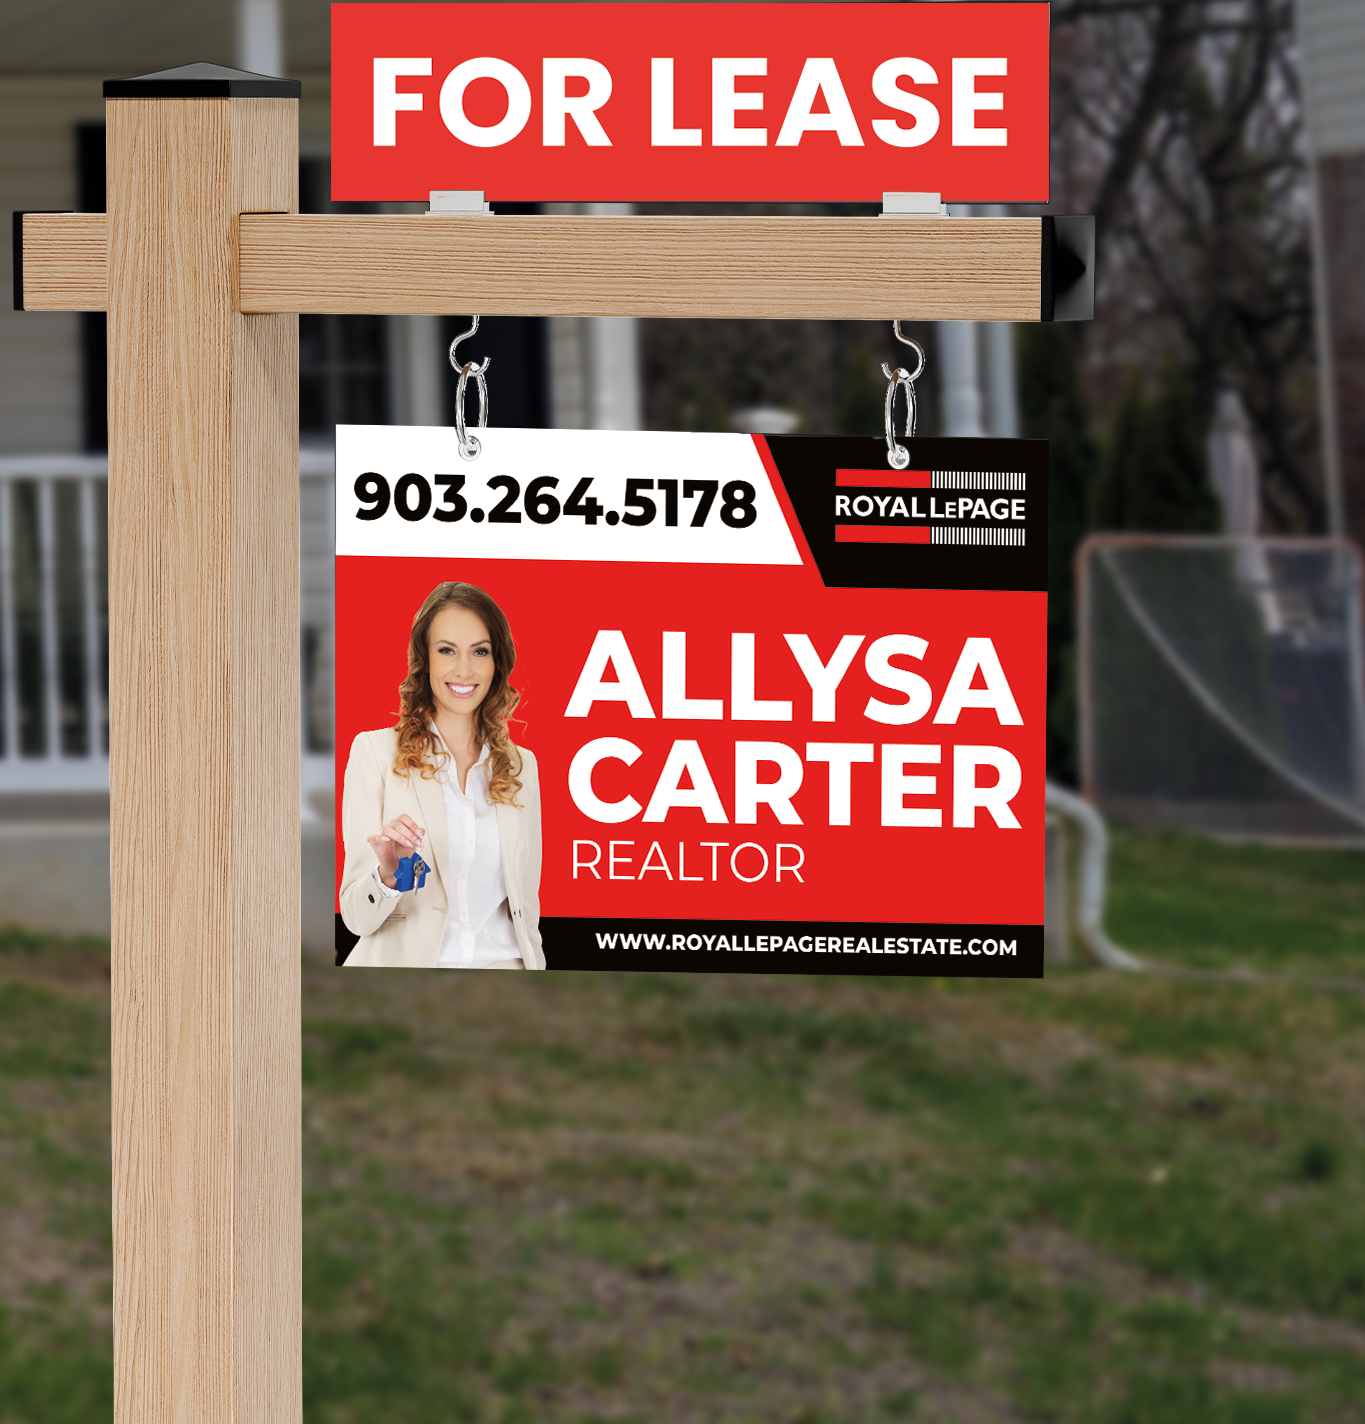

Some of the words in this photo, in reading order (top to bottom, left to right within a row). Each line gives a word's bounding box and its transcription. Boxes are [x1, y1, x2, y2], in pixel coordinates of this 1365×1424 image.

[373, 56, 613, 147] FOR
[650, 56, 1008, 147] LEASE
[353, 471, 758, 529] 903.264.5178
[835, 494, 926, 518] ROYAL
[564, 629, 1024, 726] ALLYSA
[568, 736, 1023, 830] CARTER
[572, 839, 805, 884] REALTOR
[594, 932, 1018, 957] WWW.ROYALLEPAGEREALESTATE.COM
